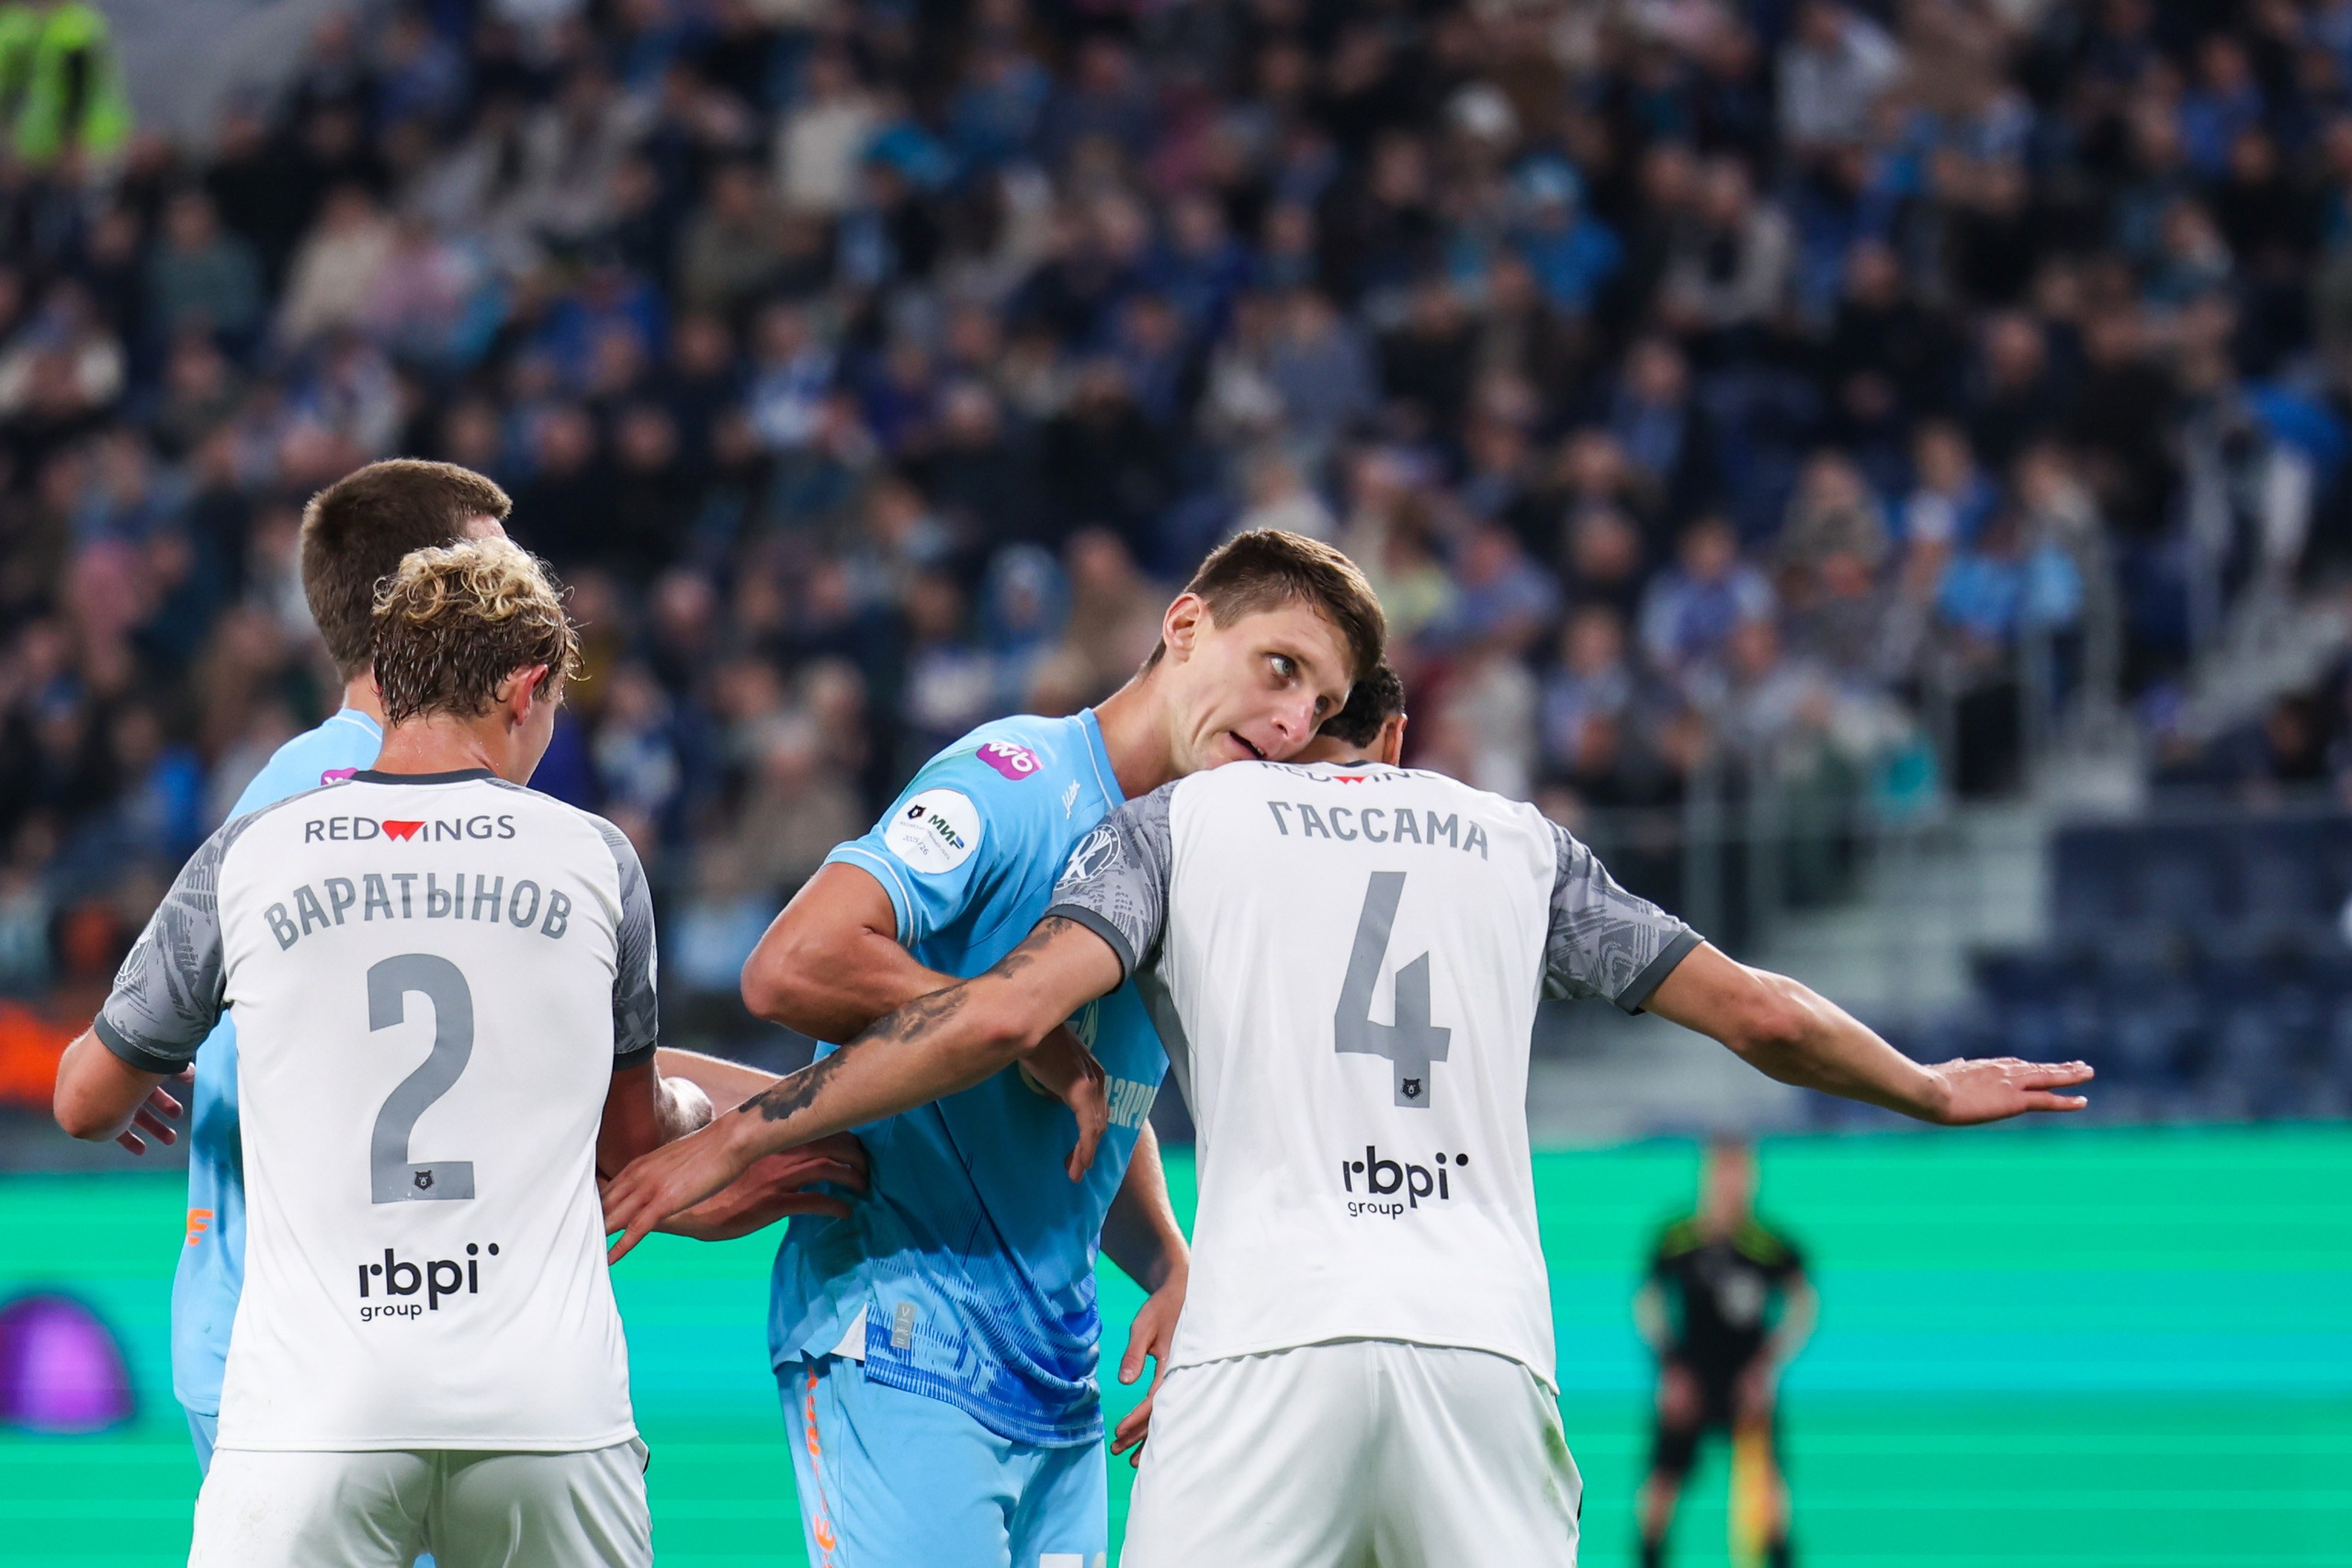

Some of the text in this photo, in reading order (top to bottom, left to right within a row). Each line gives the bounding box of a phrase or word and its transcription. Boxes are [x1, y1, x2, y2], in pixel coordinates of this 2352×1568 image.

[928, 814, 964, 850] МИР
[1267, 801, 1487, 861] ГАССАМА
[264, 873, 571, 951] ВАРАТЫНОВ
[1334, 871, 1452, 1109] 4
[368, 953, 475, 1203] 2
[1348, 1201, 1404, 1220] group
[360, 1303, 423, 1322] group
